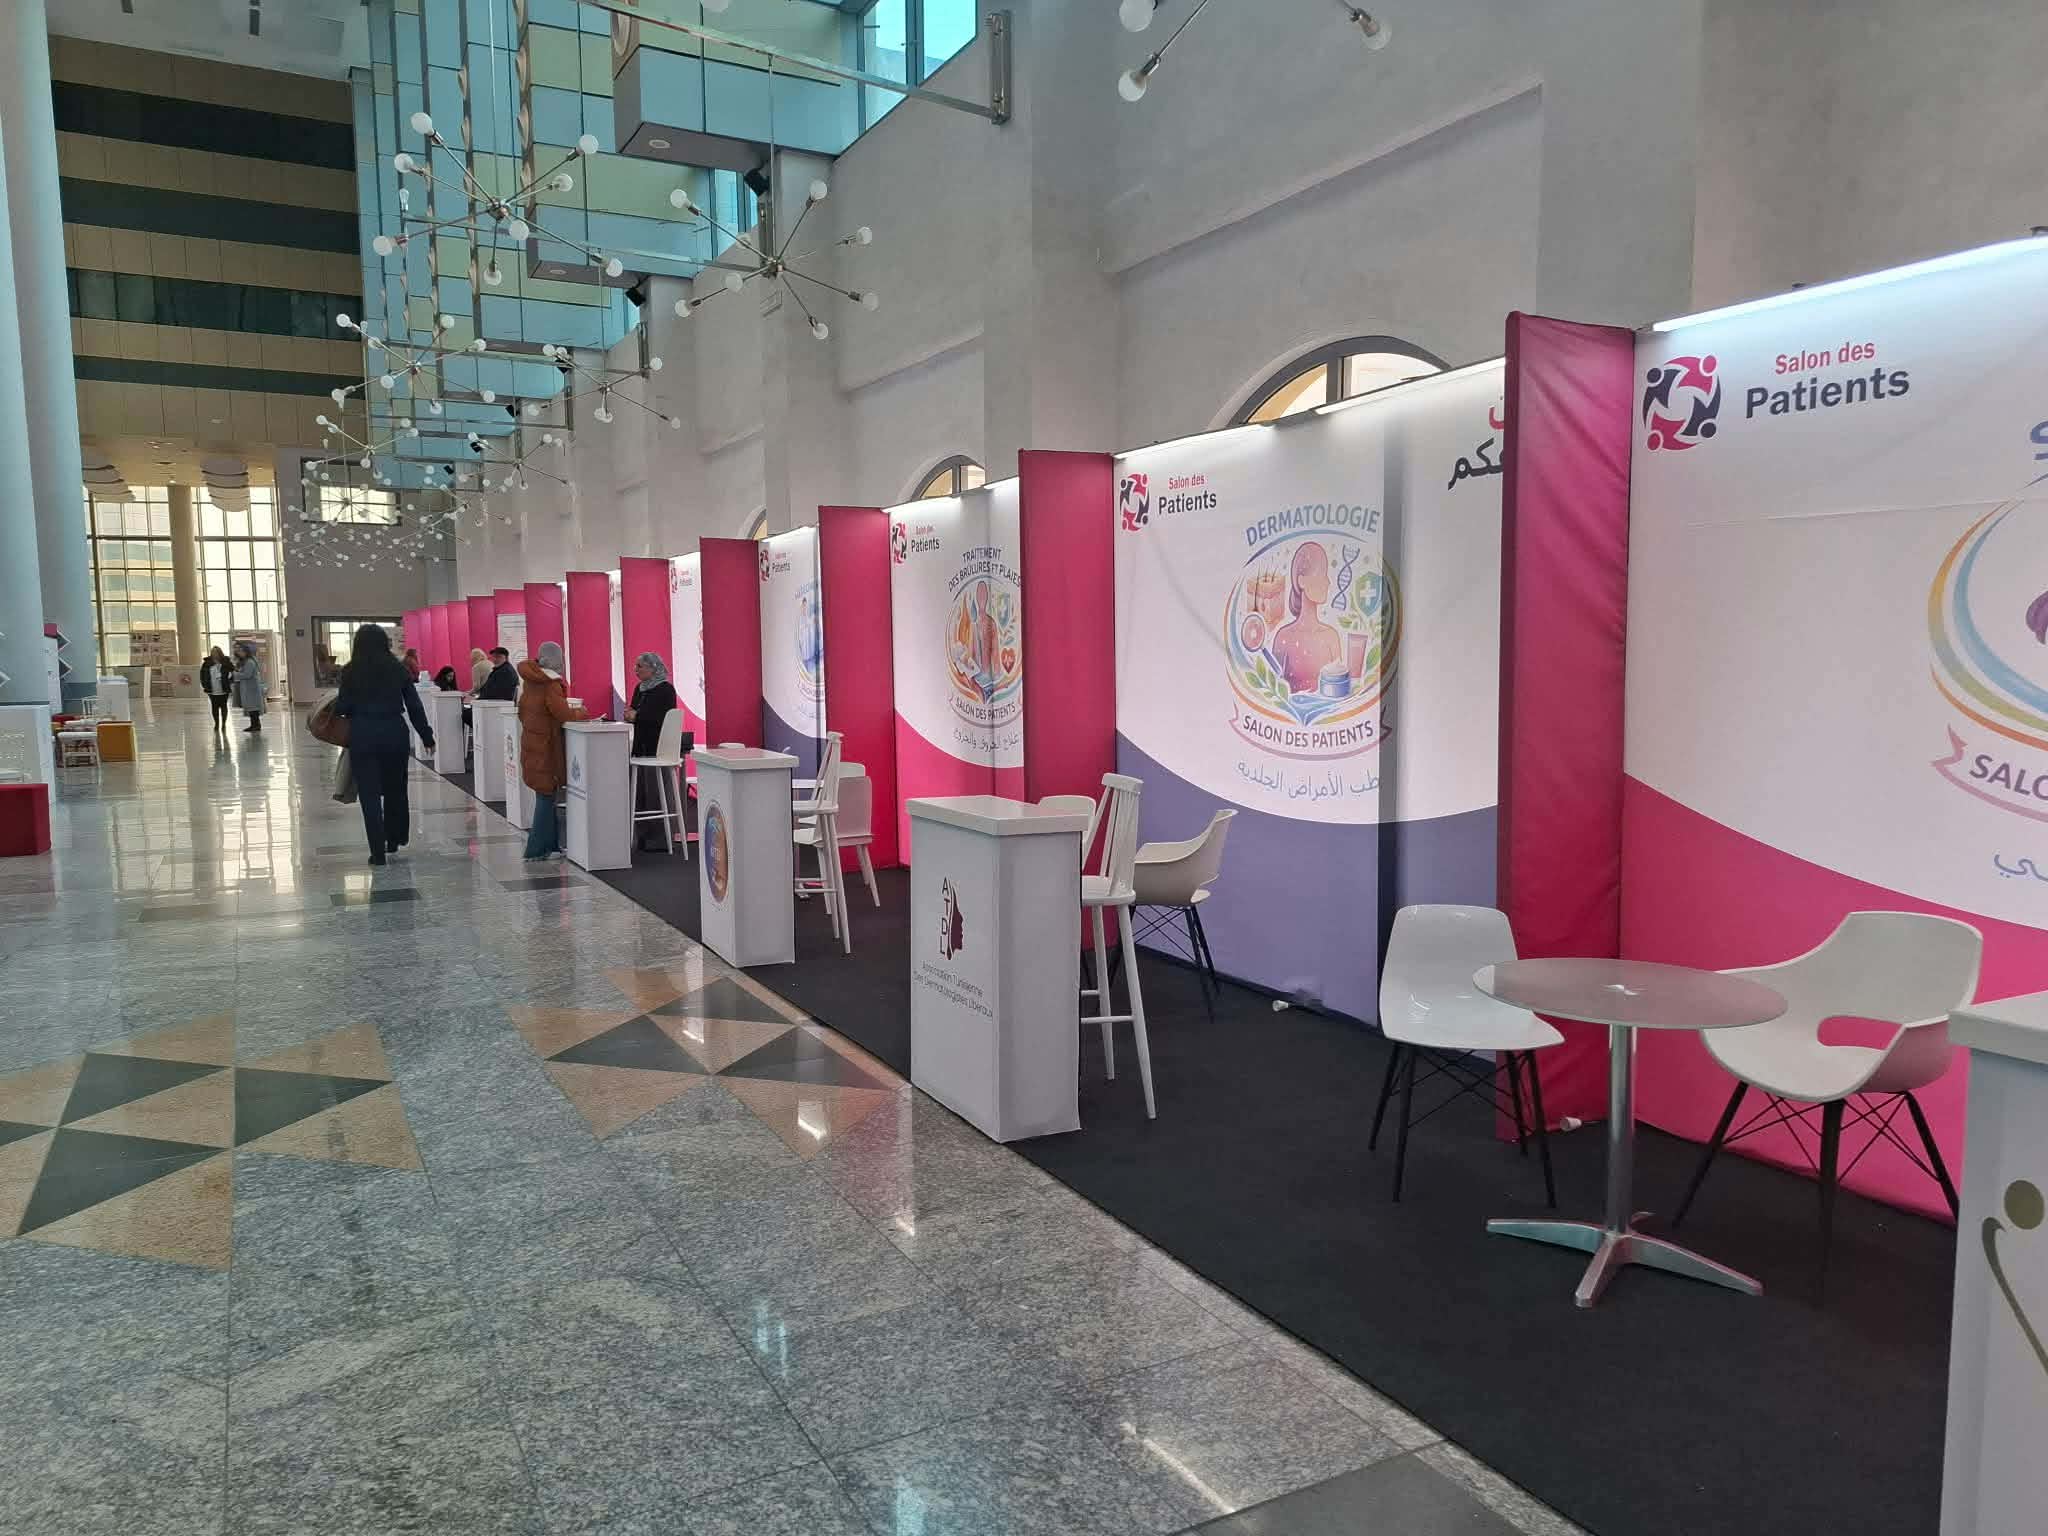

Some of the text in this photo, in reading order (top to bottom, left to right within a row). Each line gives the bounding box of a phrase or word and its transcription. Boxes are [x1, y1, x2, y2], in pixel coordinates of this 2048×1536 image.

[1775, 341, 1875, 375] Salon des
[1746, 367, 1910, 419] Patients
[1168, 473, 1205, 490] Salon des
[1158, 489, 1217, 515] Patients
[1246, 503, 1380, 546] DERMATOLOGIE
[911, 537, 940, 552] Patients
[962, 547, 1002, 563] TRAITEMENT
[948, 574, 960, 593] DES
[956, 696, 1016, 720] SALON DES PATIENTS
[1243, 715, 1374, 748] SALON DES PATIENTS
[1288, 770, 1344, 802] الأمراض
